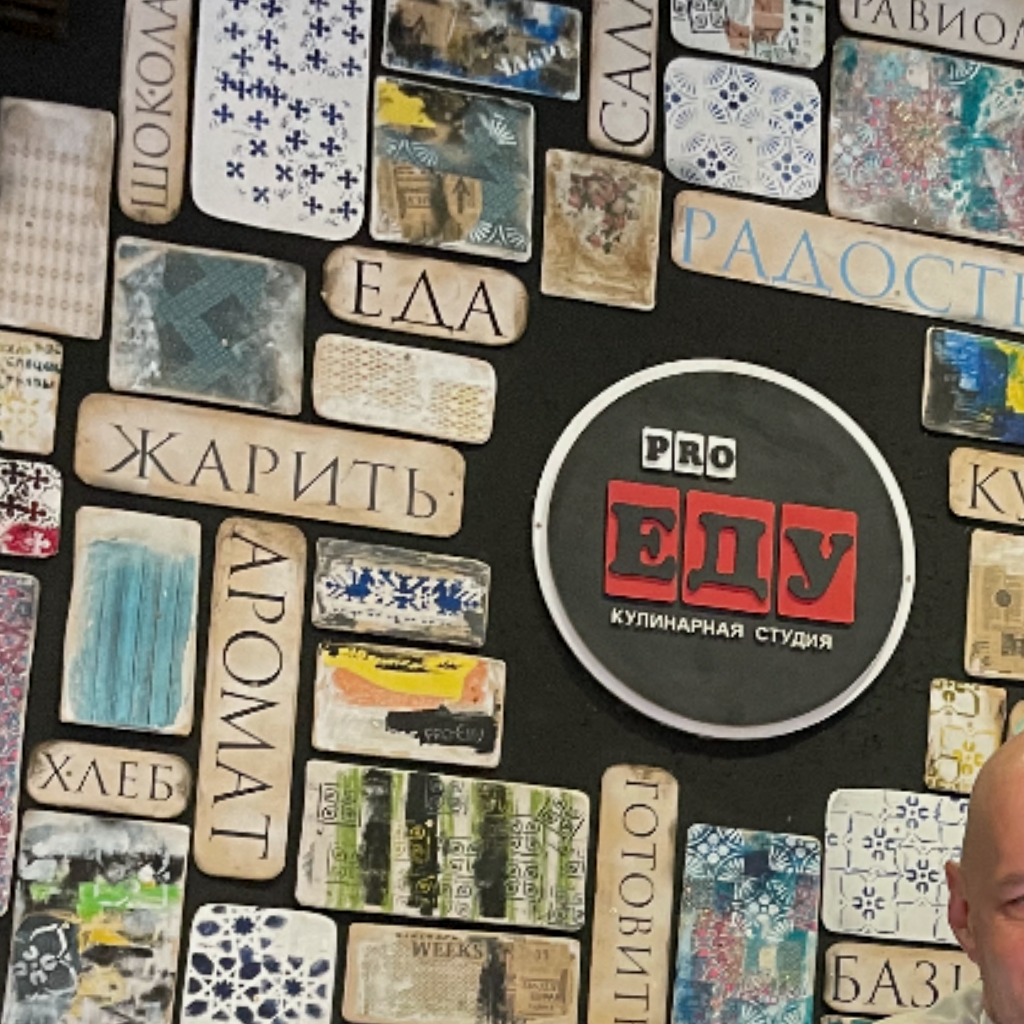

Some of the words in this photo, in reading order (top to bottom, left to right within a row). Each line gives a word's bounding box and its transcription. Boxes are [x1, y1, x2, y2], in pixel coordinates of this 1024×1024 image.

[353, 260, 508, 338] ЕДА
[105, 424, 439, 520] ЖАРИТЬ
[644, 434, 735, 469] PRO
[608, 502, 855, 602] ЕДУ
[610, 607, 745, 640] КУЛИНАРНАЯ
[755, 625, 834, 651] СТУДИЯ
[209, 531, 290, 860] АРОМАТ
[40, 752, 175, 803] ХЛЕБ
